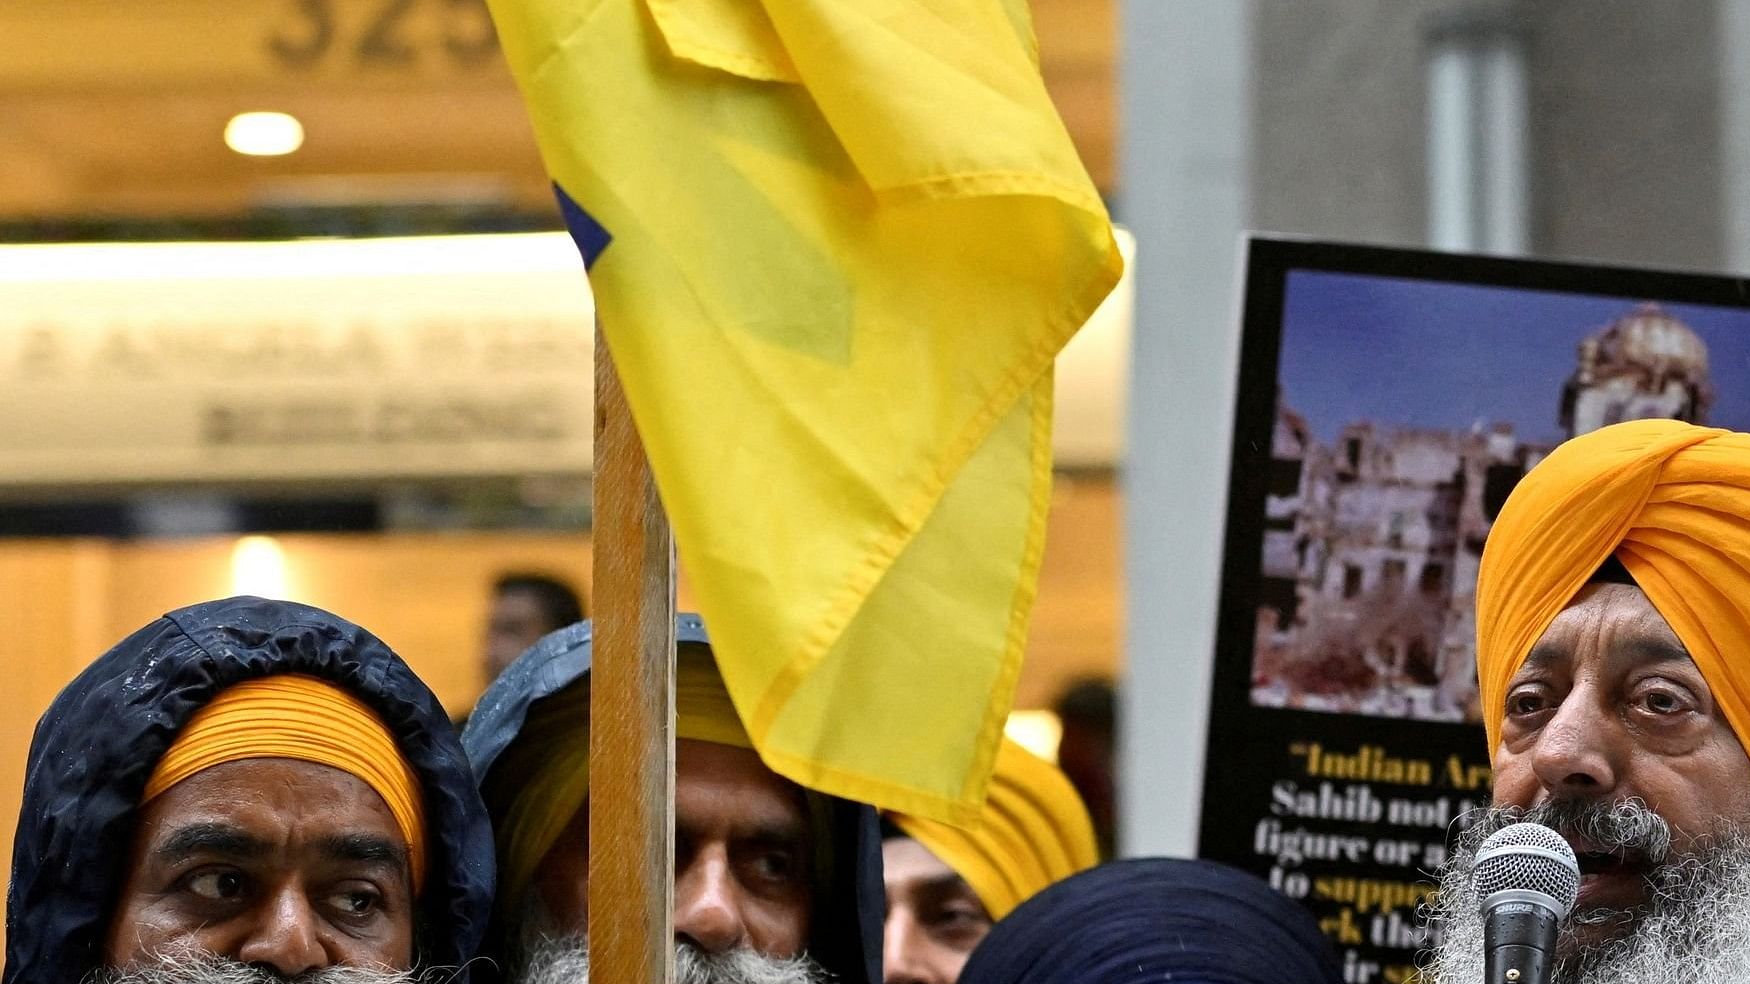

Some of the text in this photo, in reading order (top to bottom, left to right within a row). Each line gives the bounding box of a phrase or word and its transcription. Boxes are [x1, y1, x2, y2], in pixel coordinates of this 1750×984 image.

[1270, 782, 1382, 823] Sahib
[1388, 797, 1449, 829] not
[1254, 818, 1368, 867] figure
[1374, 840, 1421, 867] or
[1270, 864, 1311, 899] to
[1495, 903, 1534, 915] SHURE
